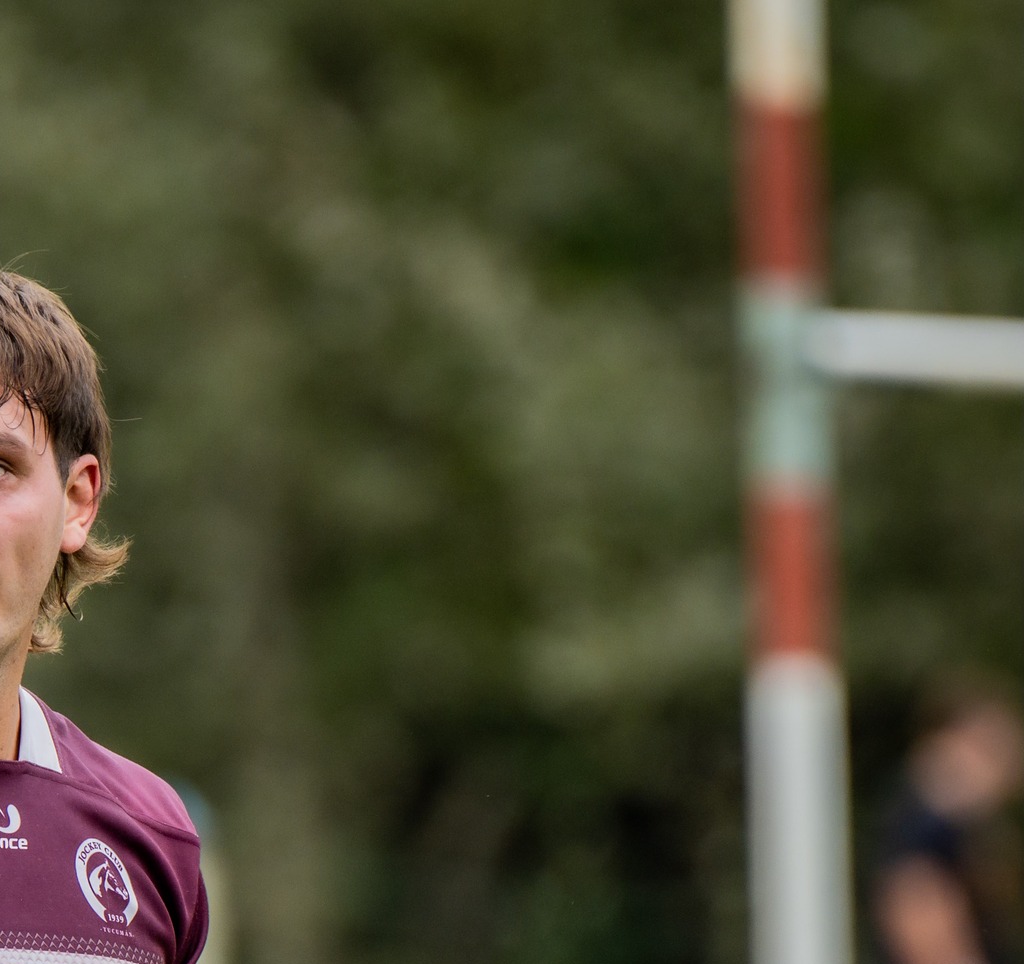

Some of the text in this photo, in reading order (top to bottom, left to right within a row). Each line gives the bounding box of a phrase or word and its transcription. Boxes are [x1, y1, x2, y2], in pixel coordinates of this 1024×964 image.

[78, 841, 123, 872] JOCKEY CLUB
[107, 913, 125, 924] 1939
